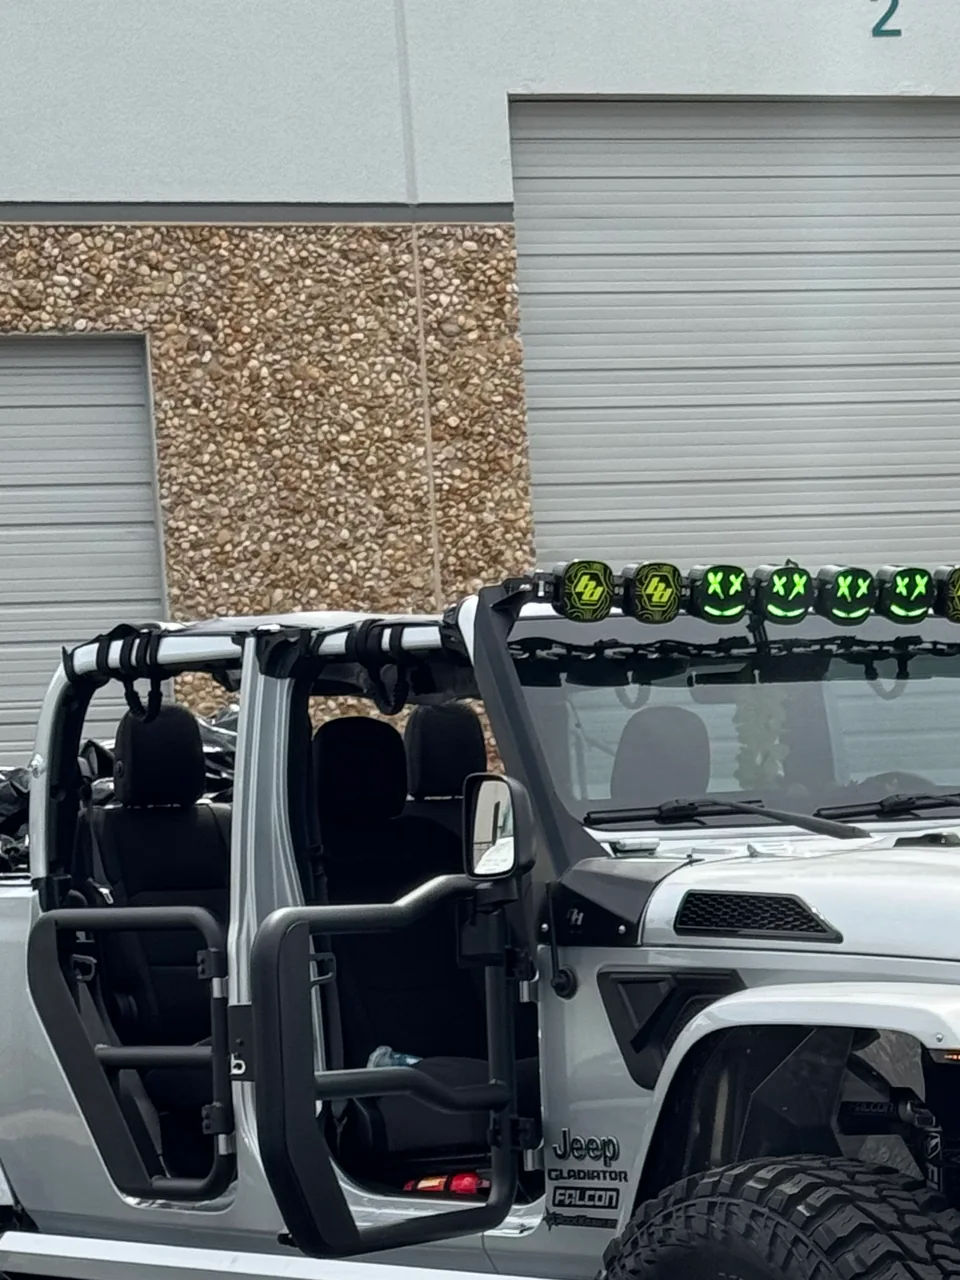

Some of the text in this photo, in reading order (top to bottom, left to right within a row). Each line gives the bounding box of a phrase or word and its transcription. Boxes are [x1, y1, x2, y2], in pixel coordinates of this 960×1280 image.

[872, 0, 902, 37] 2
[552, 1128, 620, 1167] Jeep
[548, 1168, 628, 1182] GLADIATOR
[554, 1188, 618, 1207] FALCON
